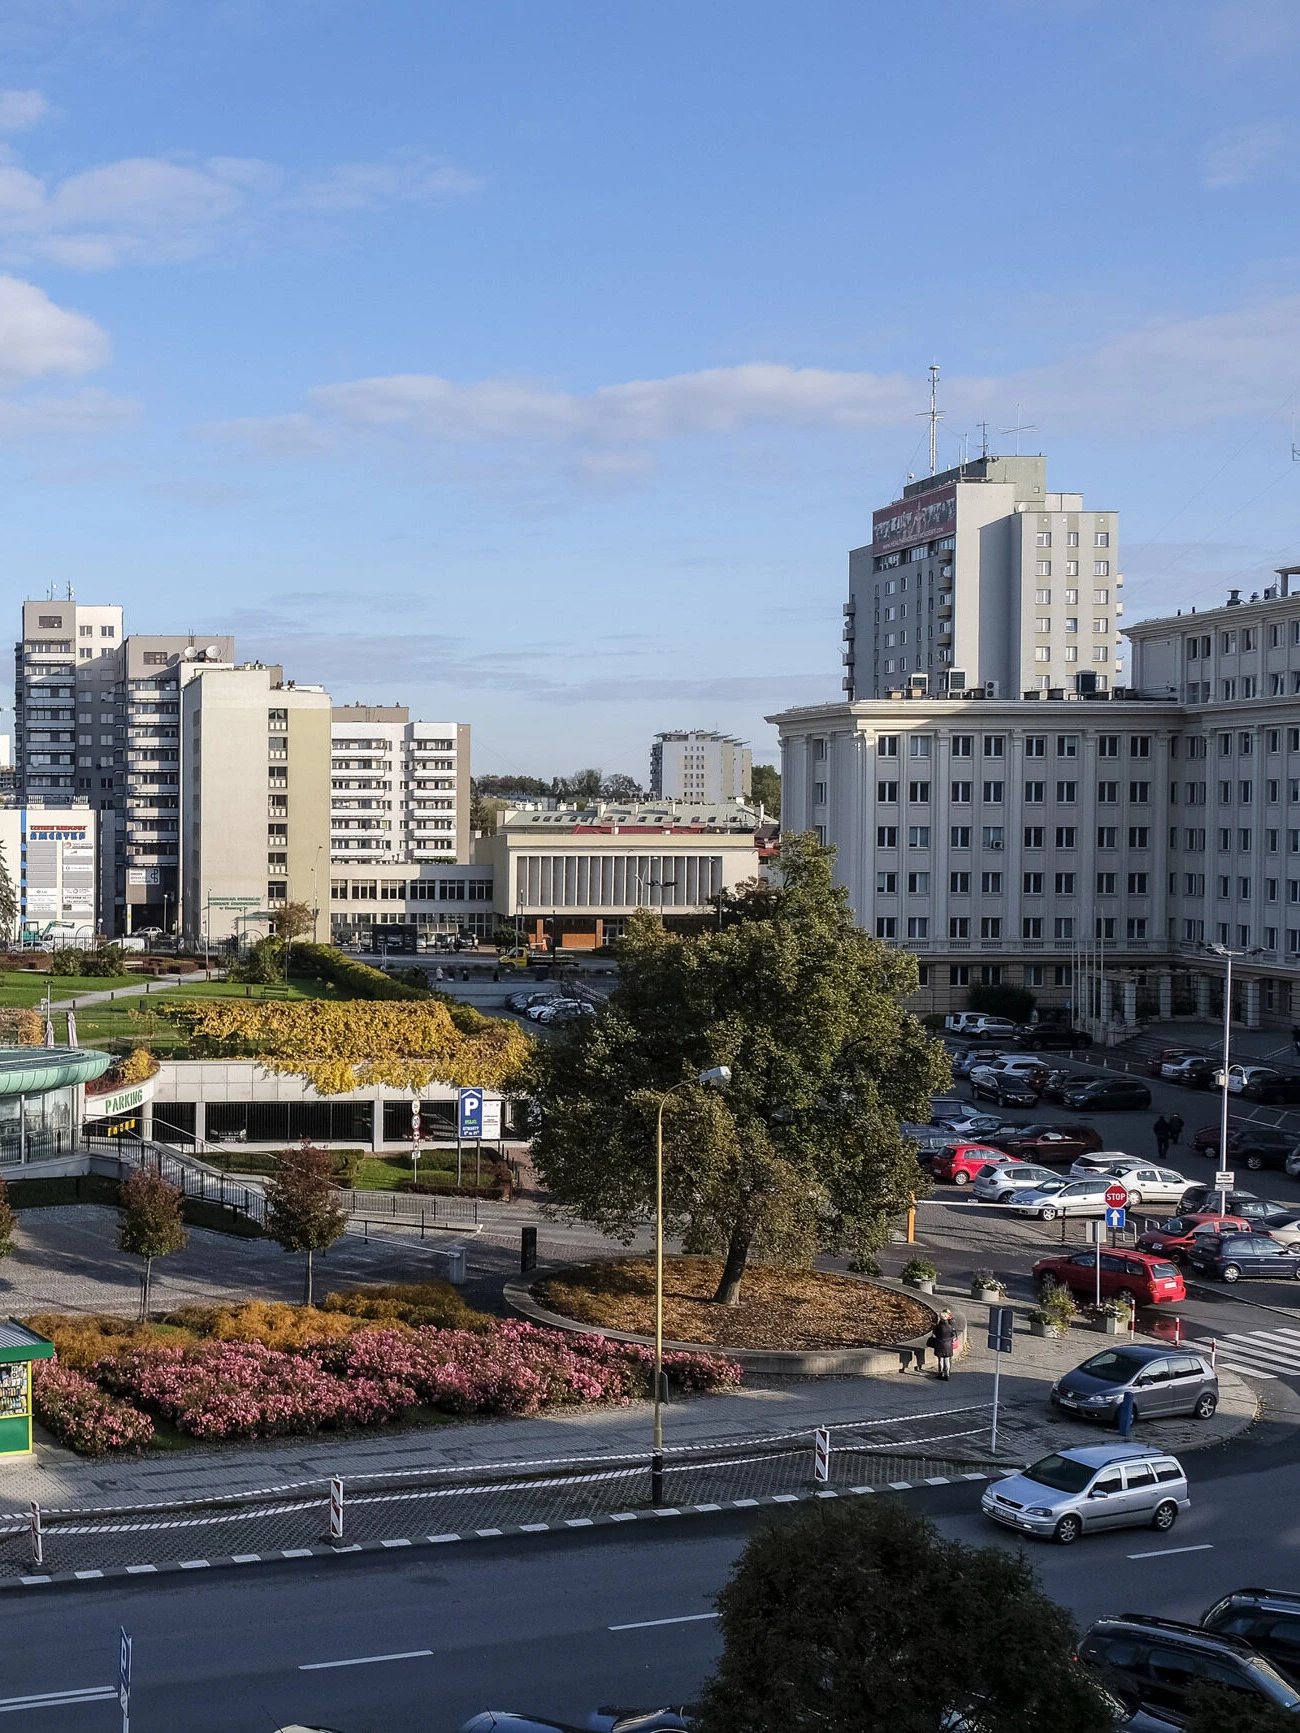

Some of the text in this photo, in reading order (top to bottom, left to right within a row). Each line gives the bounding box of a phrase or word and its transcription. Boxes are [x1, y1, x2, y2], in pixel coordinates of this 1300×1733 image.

[105, 1089, 143, 1114] PARKING
[464, 1098, 479, 1117] P
[1106, 1193, 1126, 1201] STOP
